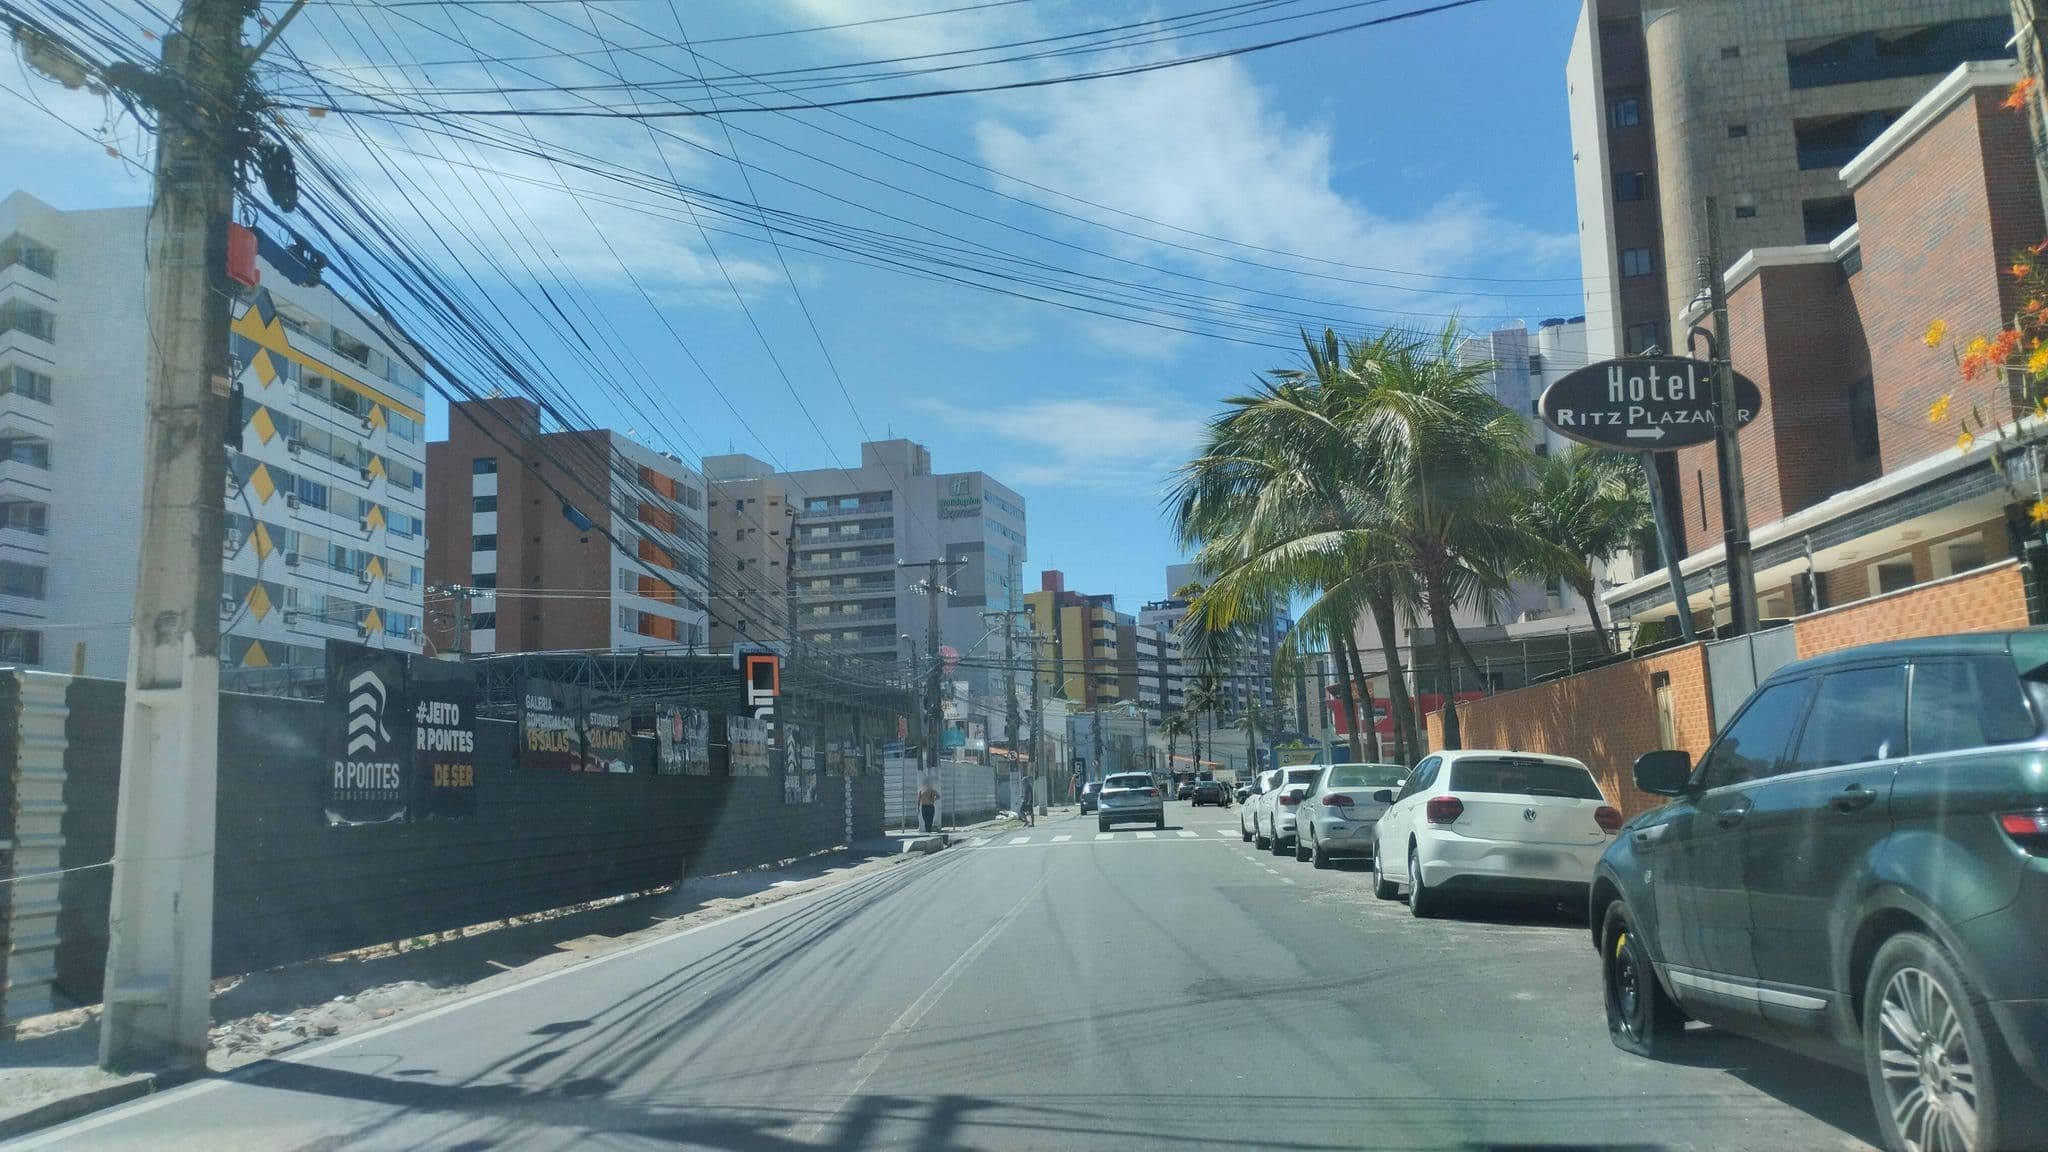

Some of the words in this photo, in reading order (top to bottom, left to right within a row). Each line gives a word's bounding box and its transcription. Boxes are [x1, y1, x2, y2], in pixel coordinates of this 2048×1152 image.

[1608, 364, 1696, 402] Hotel
[416, 700, 459, 726] #JEITO
[525, 694, 553, 711] GALERIA
[417, 727, 426, 750] R
[428, 728, 474, 752] PONTES
[538, 730, 569, 752] SALAS
[334, 761, 344, 788] R
[347, 762, 400, 789] PONTES
[434, 764, 450, 787] DE
[451, 764, 473, 786] SER
